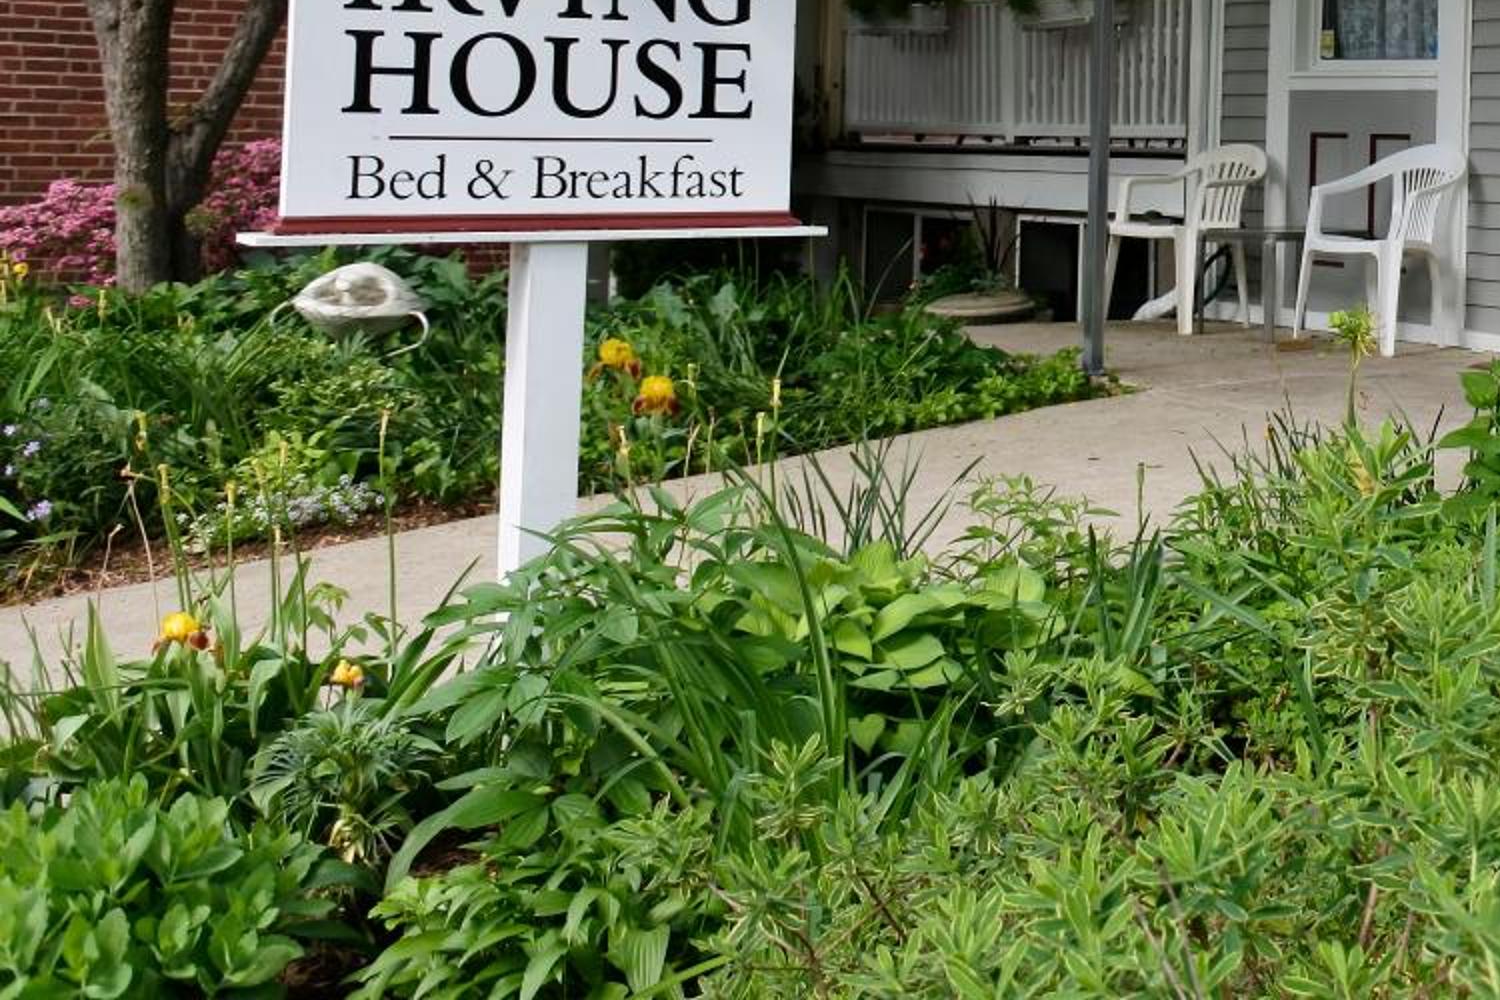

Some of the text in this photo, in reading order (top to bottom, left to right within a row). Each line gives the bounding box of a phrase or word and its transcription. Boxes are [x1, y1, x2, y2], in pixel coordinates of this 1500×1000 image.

[341, 29, 754, 120] HOUSE
[347, 153, 745, 202] Bed & Breakfast
